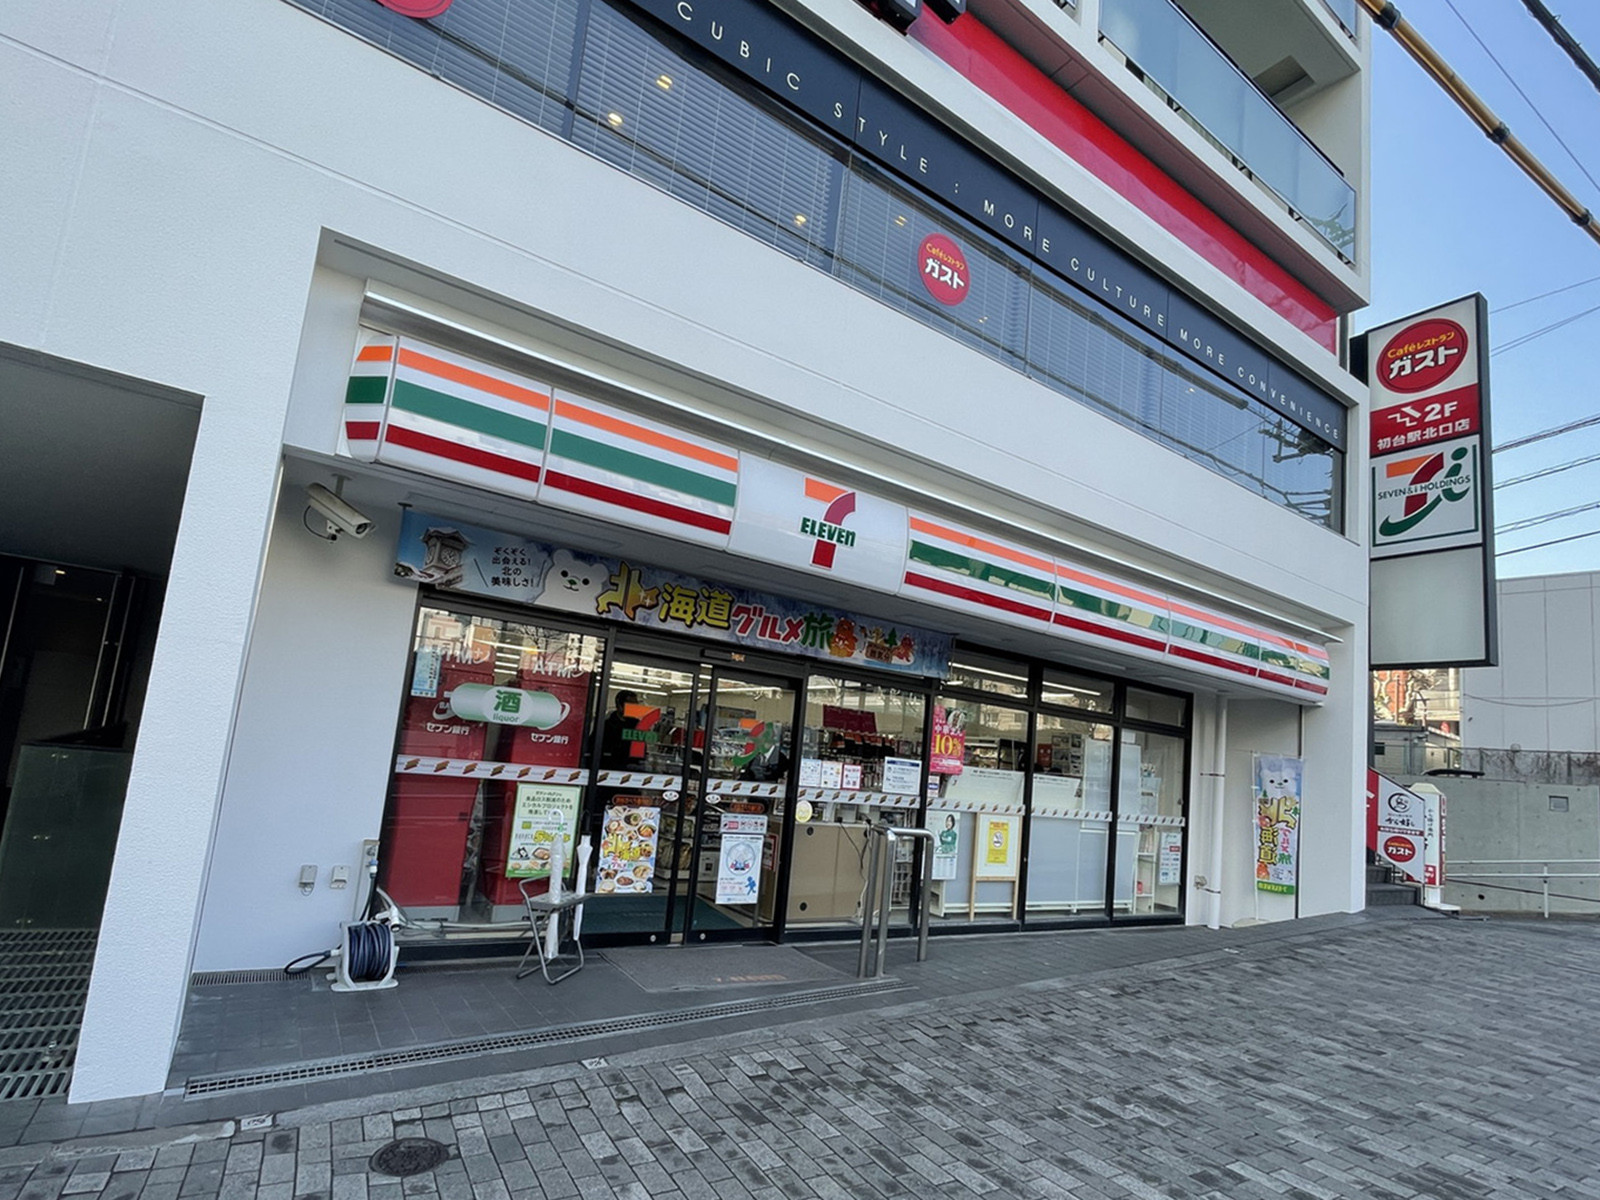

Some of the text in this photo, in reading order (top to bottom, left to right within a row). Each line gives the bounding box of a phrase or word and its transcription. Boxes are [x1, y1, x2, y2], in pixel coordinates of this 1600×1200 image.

[677, 1, 800, 91] CUBIC
[834, 102, 928, 173] STYLE
[984, 199, 1050, 253] MORE
[1070, 257, 1165, 327] CULTURE
[1180, 328, 1224, 366] MORE
[1237, 366, 1338, 439] CONVENIENCE
[925, 258, 965, 289] ガスト
[1389, 345, 1458, 379] ガスト
[1424, 401, 1459, 422] 2F
[1377, 418, 1470, 450] 初台駅北口店
[1419, 474, 1471, 496] HOLDINGS
[491, 576, 534, 587] 美味しさ!
[502, 567, 522, 576] 北の
[532, 655, 571, 678] ATM
[493, 690, 522, 714] 酒
[493, 713, 520, 723] liquor
[426, 722, 470, 736] セブン銀行
[531, 732, 569, 745] セブン銀行
[1387, 846, 1412, 856] ガスト
